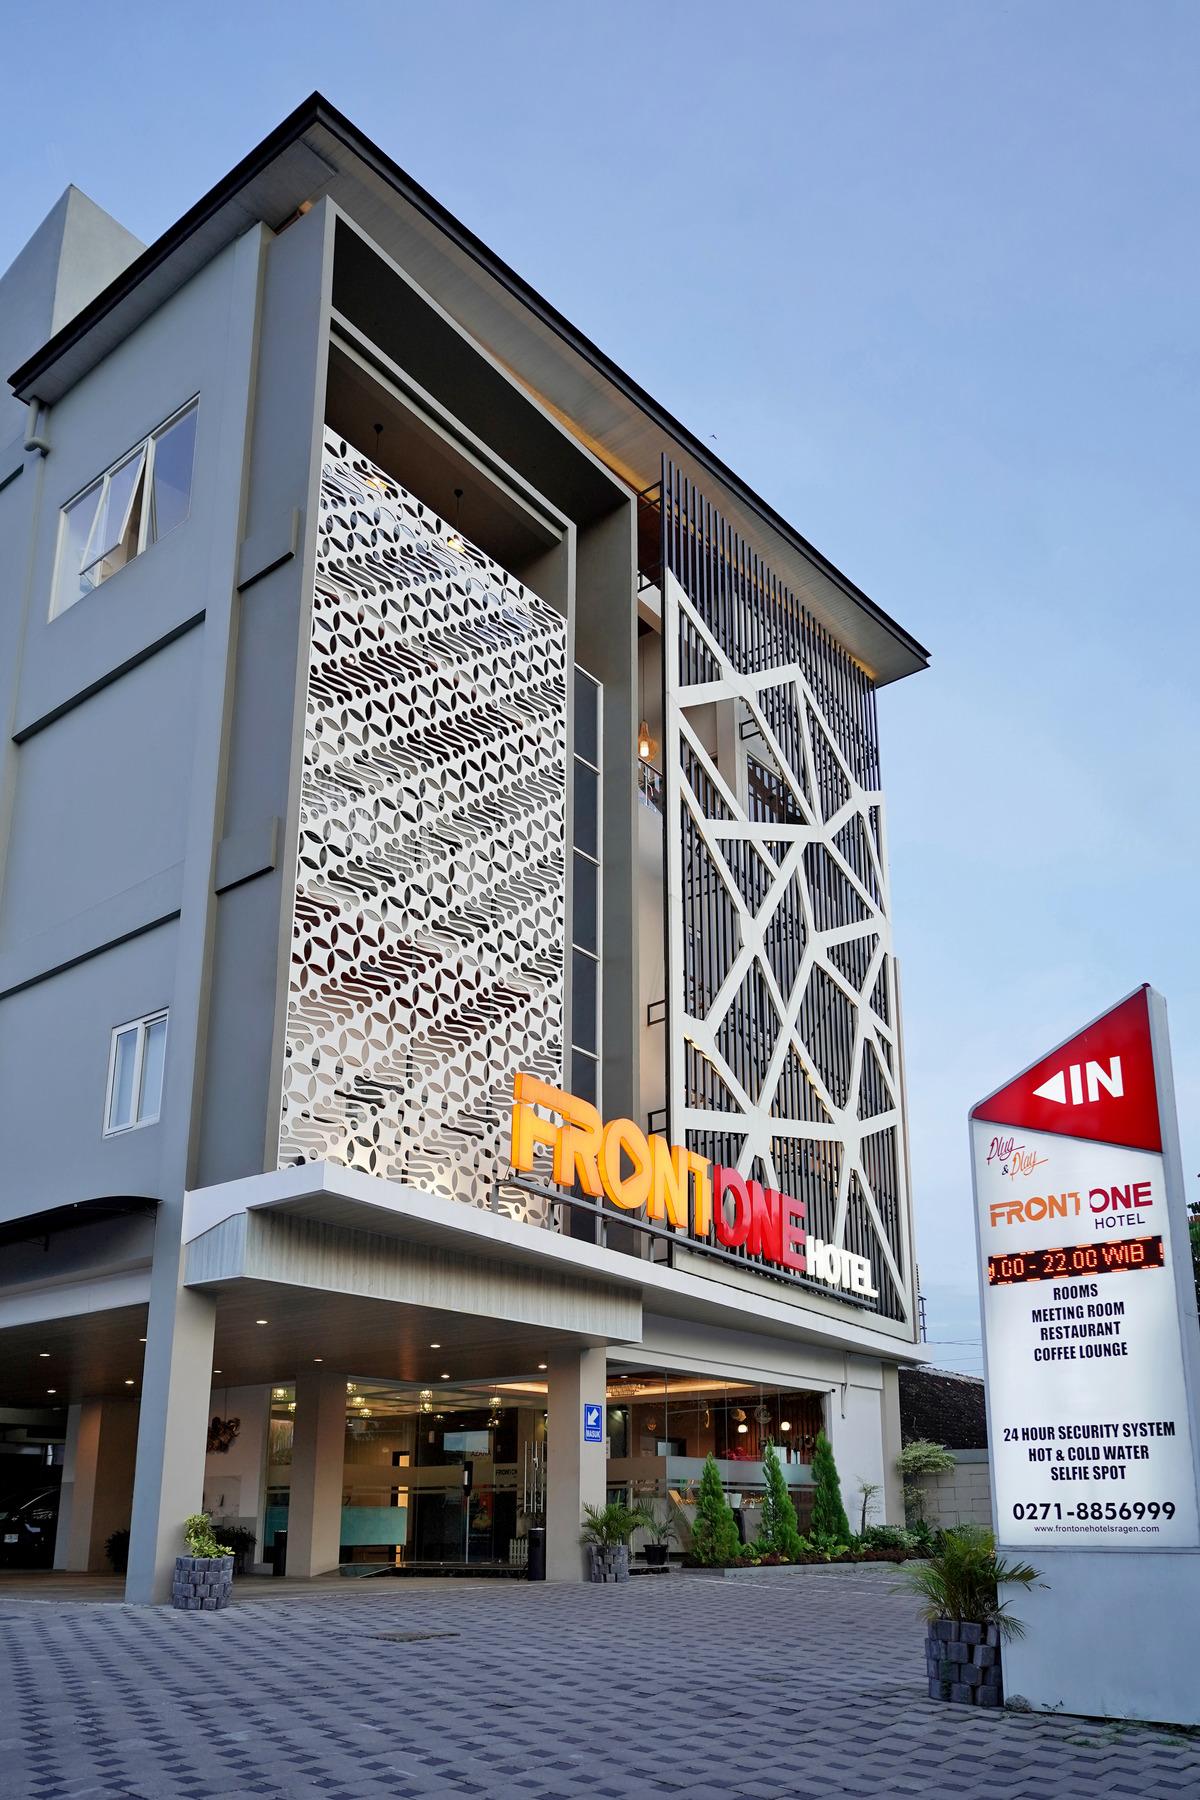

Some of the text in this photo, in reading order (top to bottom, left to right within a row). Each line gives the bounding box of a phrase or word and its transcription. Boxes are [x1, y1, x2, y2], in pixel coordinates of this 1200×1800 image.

[1069, 1056, 1124, 1105] IN
[987, 1136, 1026, 1165] Plug
[1001, 1151, 1049, 1181] & Play
[510, 1072, 879, 1298] FRONT ONE HOTEL
[990, 1181, 1153, 1227] FRONT ONE
[1095, 1213, 1146, 1229] HOTEL
[1043, 1249, 1098, 1273] 22.00
[1102, 1243, 1144, 1265] WIB
[1053, 1283, 1098, 1300] ROOMS
[1032, 1301, 1125, 1323] MEETING ROOM
[1040, 1321, 1121, 1341] RESTAURANT
[1034, 1342, 1128, 1362] COFFEE LOUNGE
[1003, 1421, 1176, 1441] 24 HOUR SECURITY SYSTEM
[1028, 1444, 1150, 1462] HOT & COLD WATER
[1050, 1465, 1126, 1481] SELFIE SPOT
[1012, 1501, 1176, 1520] 0271-8856999
[1034, 1525, 1160, 1534] www.frontonehotelsragen.com
